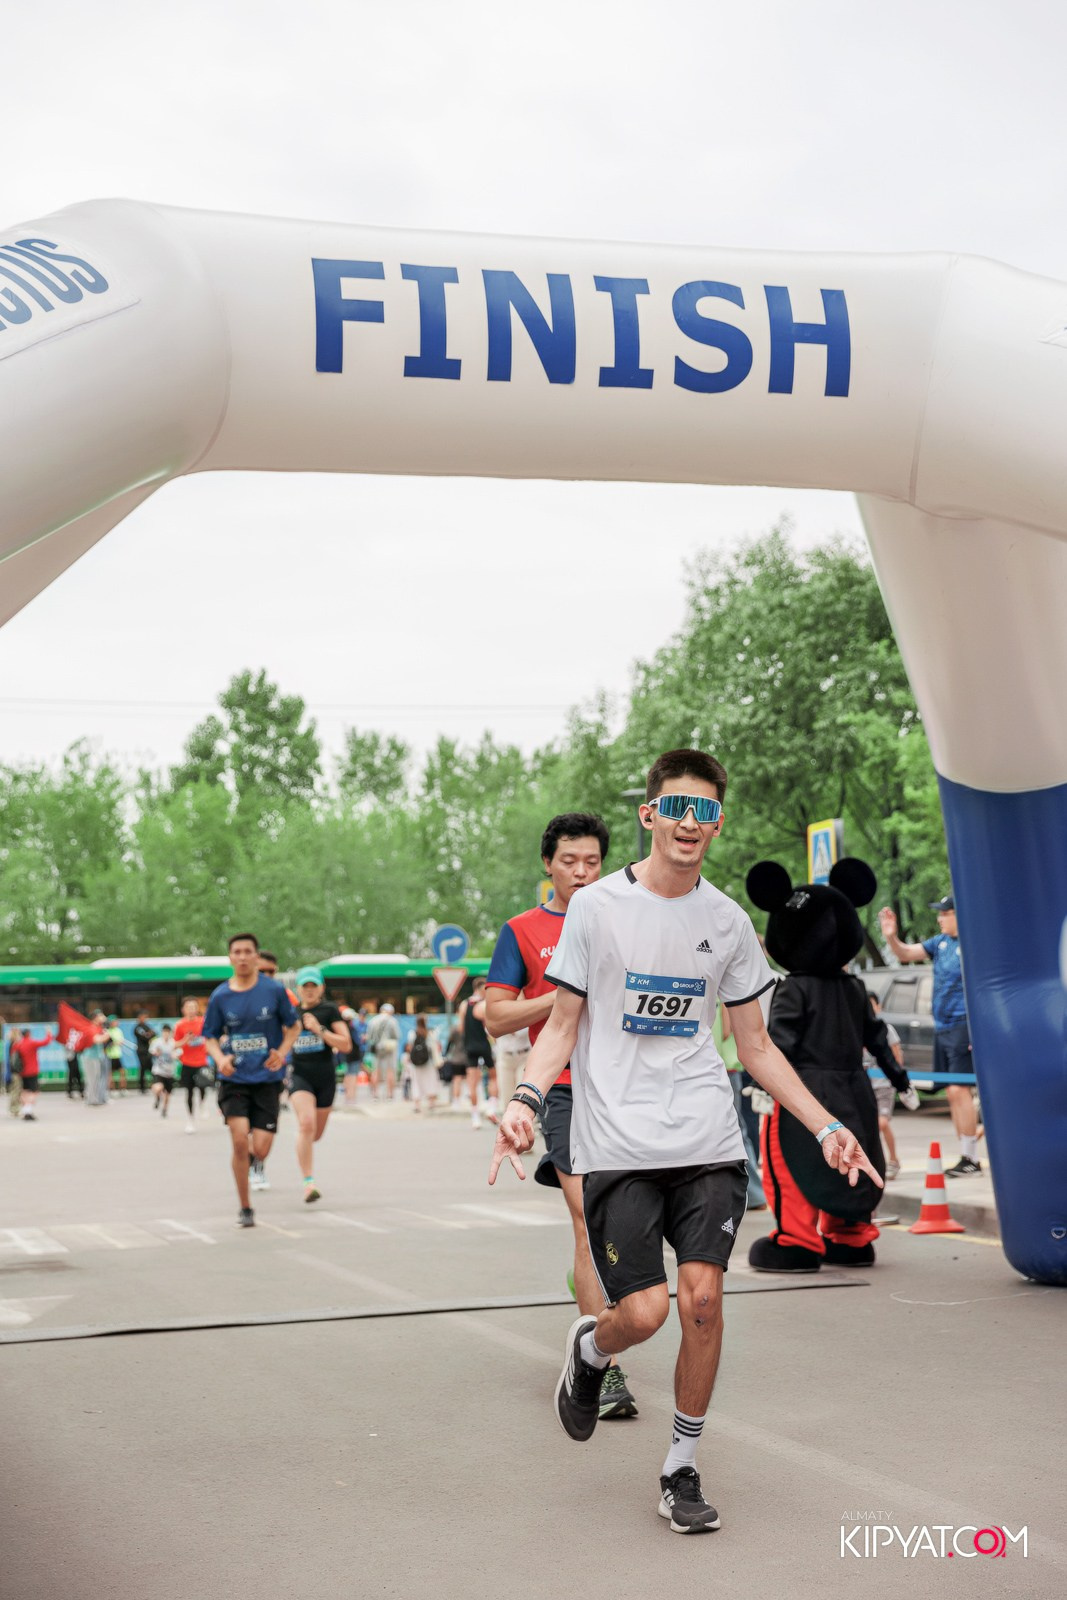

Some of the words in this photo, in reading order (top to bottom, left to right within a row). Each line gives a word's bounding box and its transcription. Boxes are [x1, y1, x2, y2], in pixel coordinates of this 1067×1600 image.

[311, 258, 851, 397] FINISH
[629, 976, 637, 984] 5
[636, 995, 693, 1017] 1691
